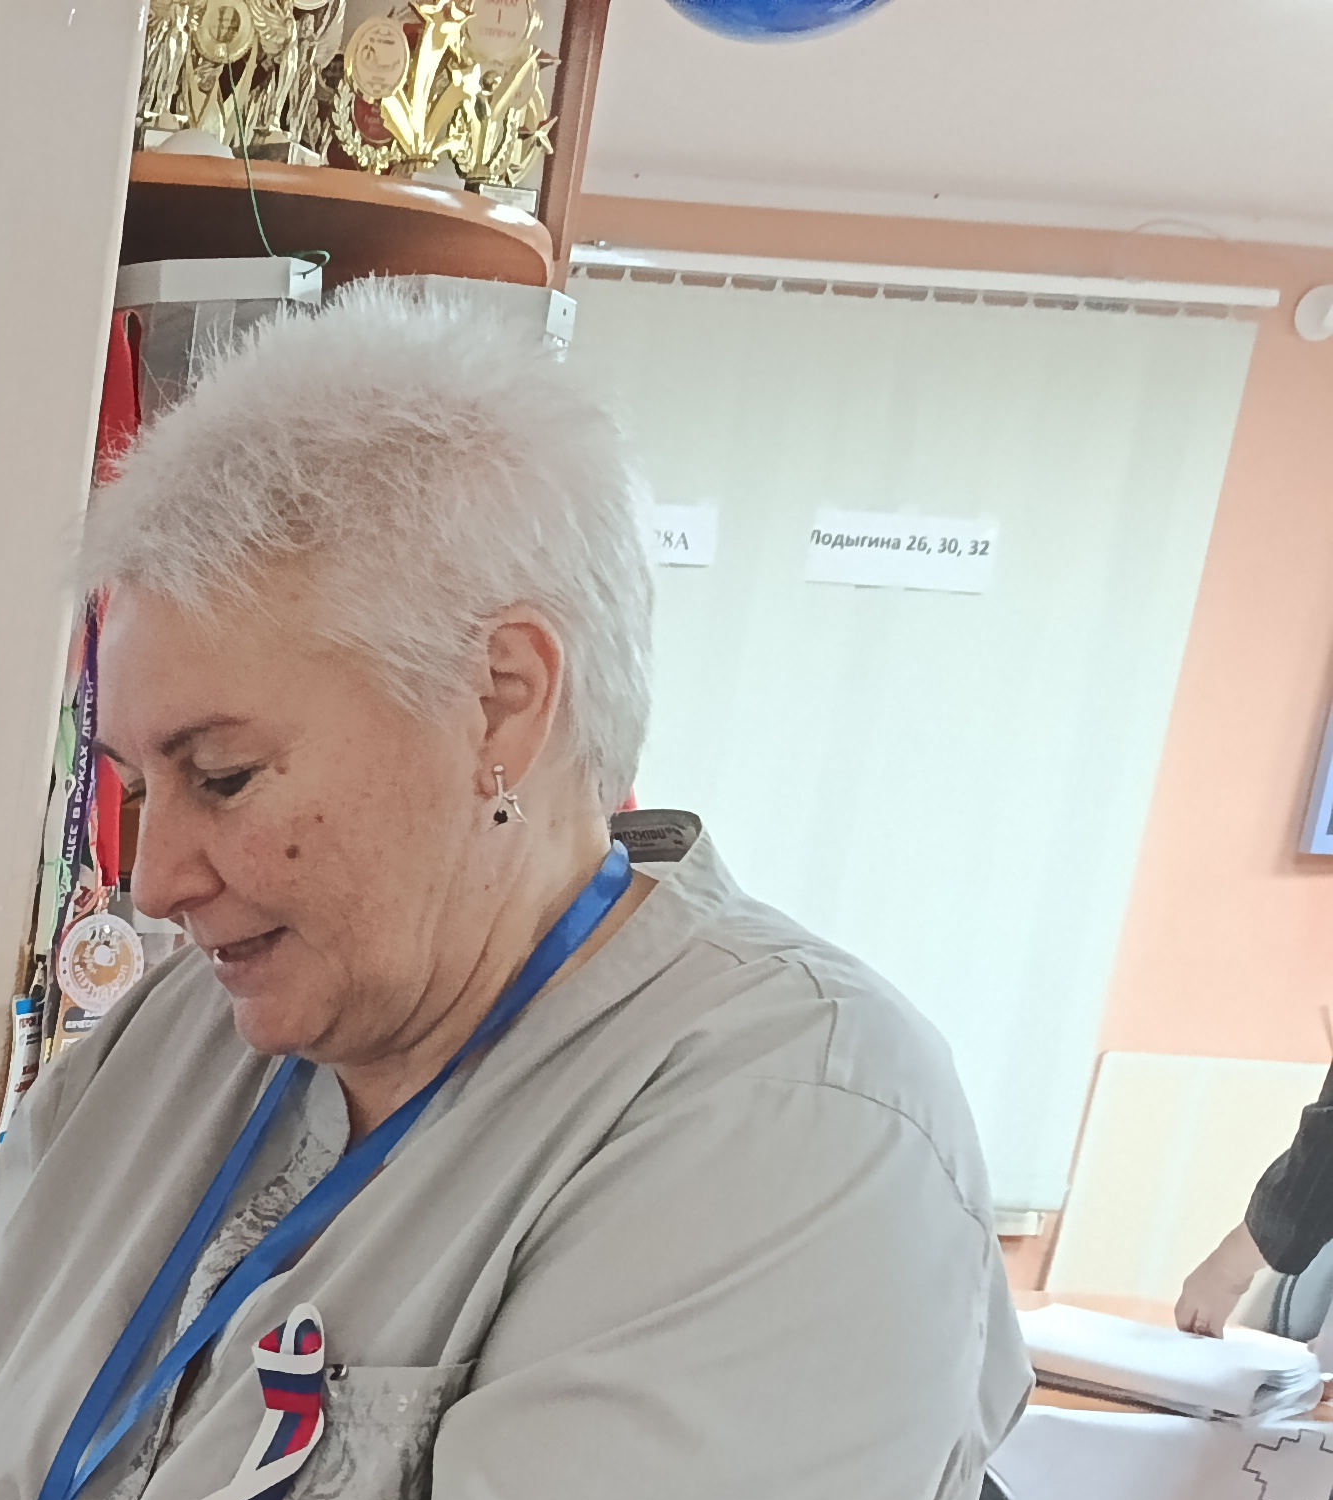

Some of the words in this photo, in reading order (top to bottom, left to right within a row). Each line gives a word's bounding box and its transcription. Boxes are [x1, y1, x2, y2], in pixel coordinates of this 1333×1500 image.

[809, 528, 901, 551] Лодыгина
[906, 534, 932, 556] 26,
[936, 536, 962, 557] 30,
[968, 539, 991, 557] 32
[75, 745, 89, 805] РУКАХ
